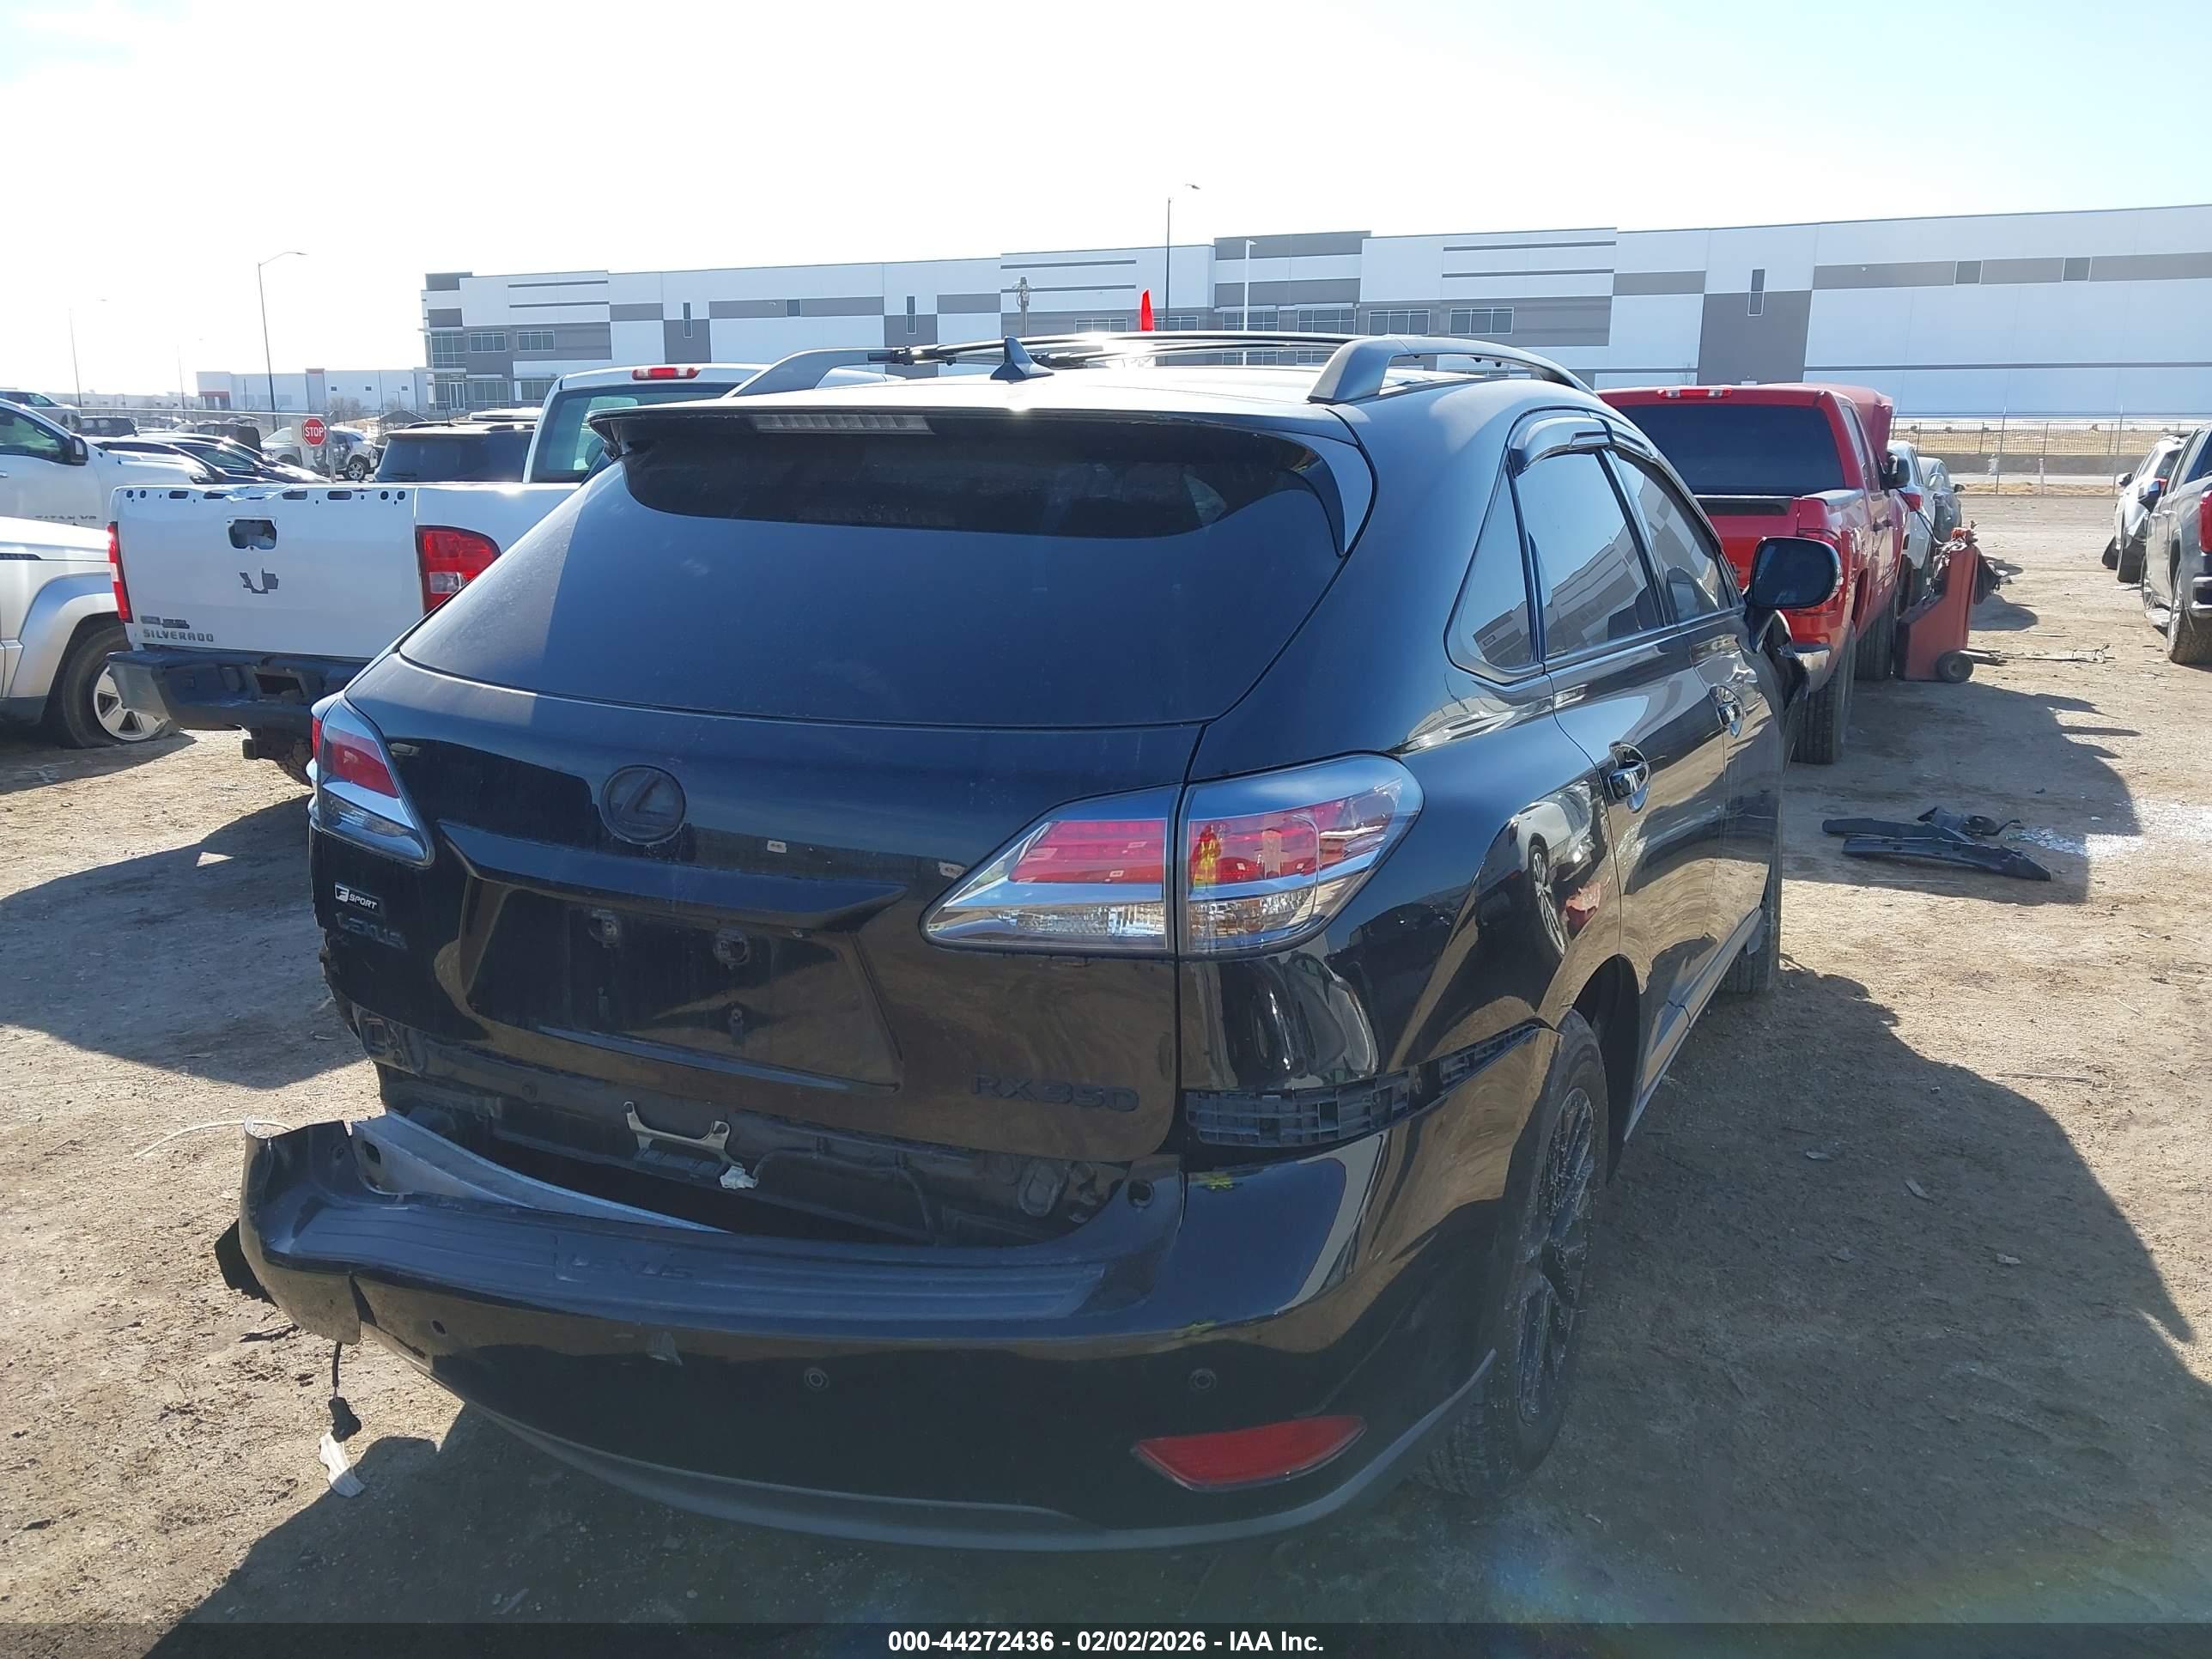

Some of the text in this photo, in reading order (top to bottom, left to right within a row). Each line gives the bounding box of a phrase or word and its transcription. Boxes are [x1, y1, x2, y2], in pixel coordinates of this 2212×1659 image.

[305, 426, 324, 437] STOP
[143, 629, 214, 642] SILVERADO
[349, 893, 378, 909] SPORT
[970, 1074, 1140, 1114] RX 350
